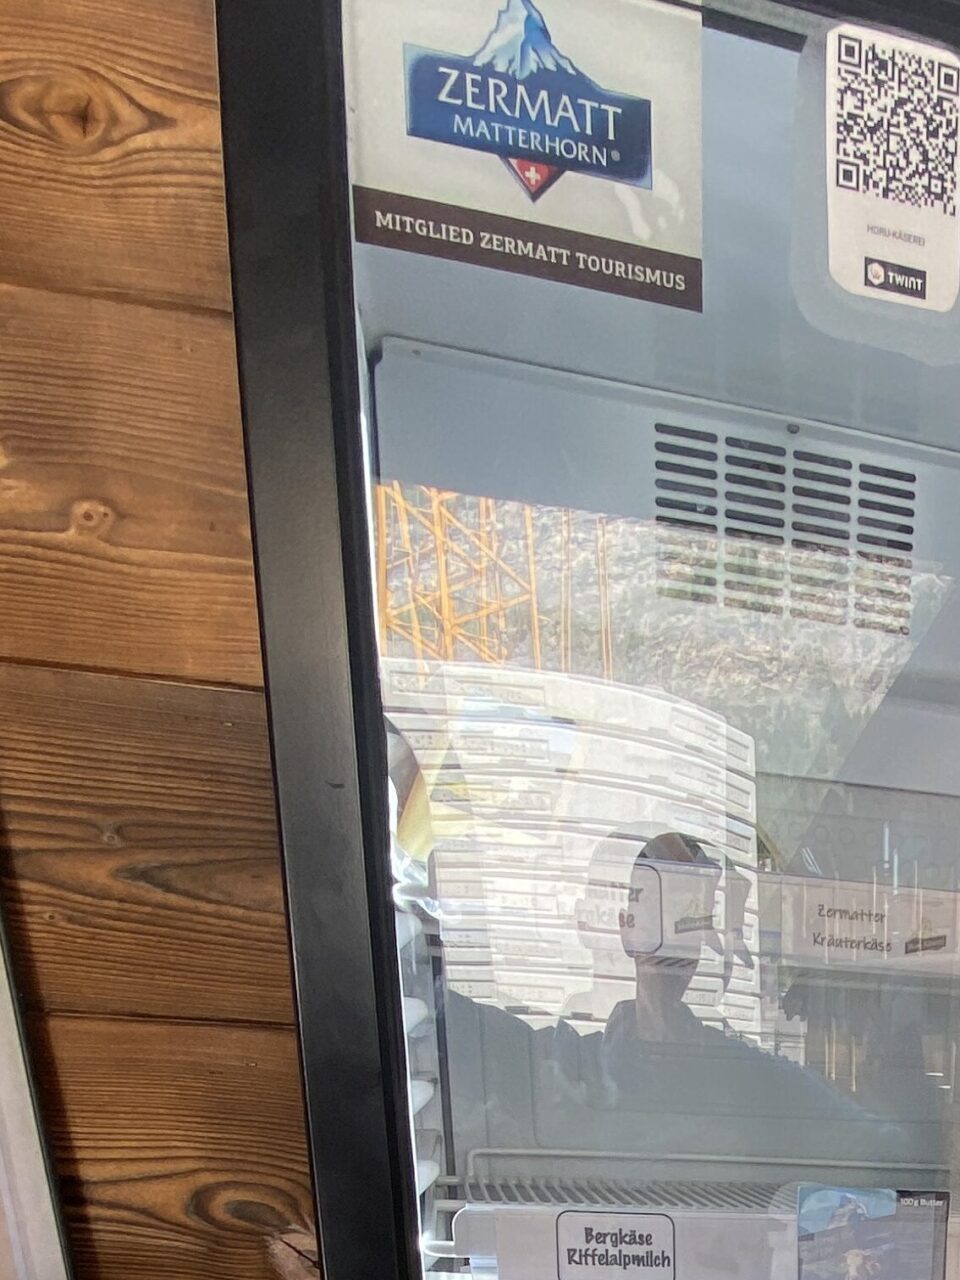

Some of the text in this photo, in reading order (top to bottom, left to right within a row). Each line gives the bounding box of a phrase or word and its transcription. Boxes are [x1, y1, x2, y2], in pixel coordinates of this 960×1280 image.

[437, 66, 622, 140] ZERMATT
[453, 114, 607, 167] MATTERHORN
[375, 210, 686, 291] MITGLIED ZERMATT TOURISMUS
[887, 270, 923, 292] TWINT
[817, 903, 887, 924] Zermatter
[811, 931, 893, 952] Kräuterkäse
[582, 1225, 654, 1248] Bergkäse
[565, 1246, 671, 1272] Riffelalpmilch
